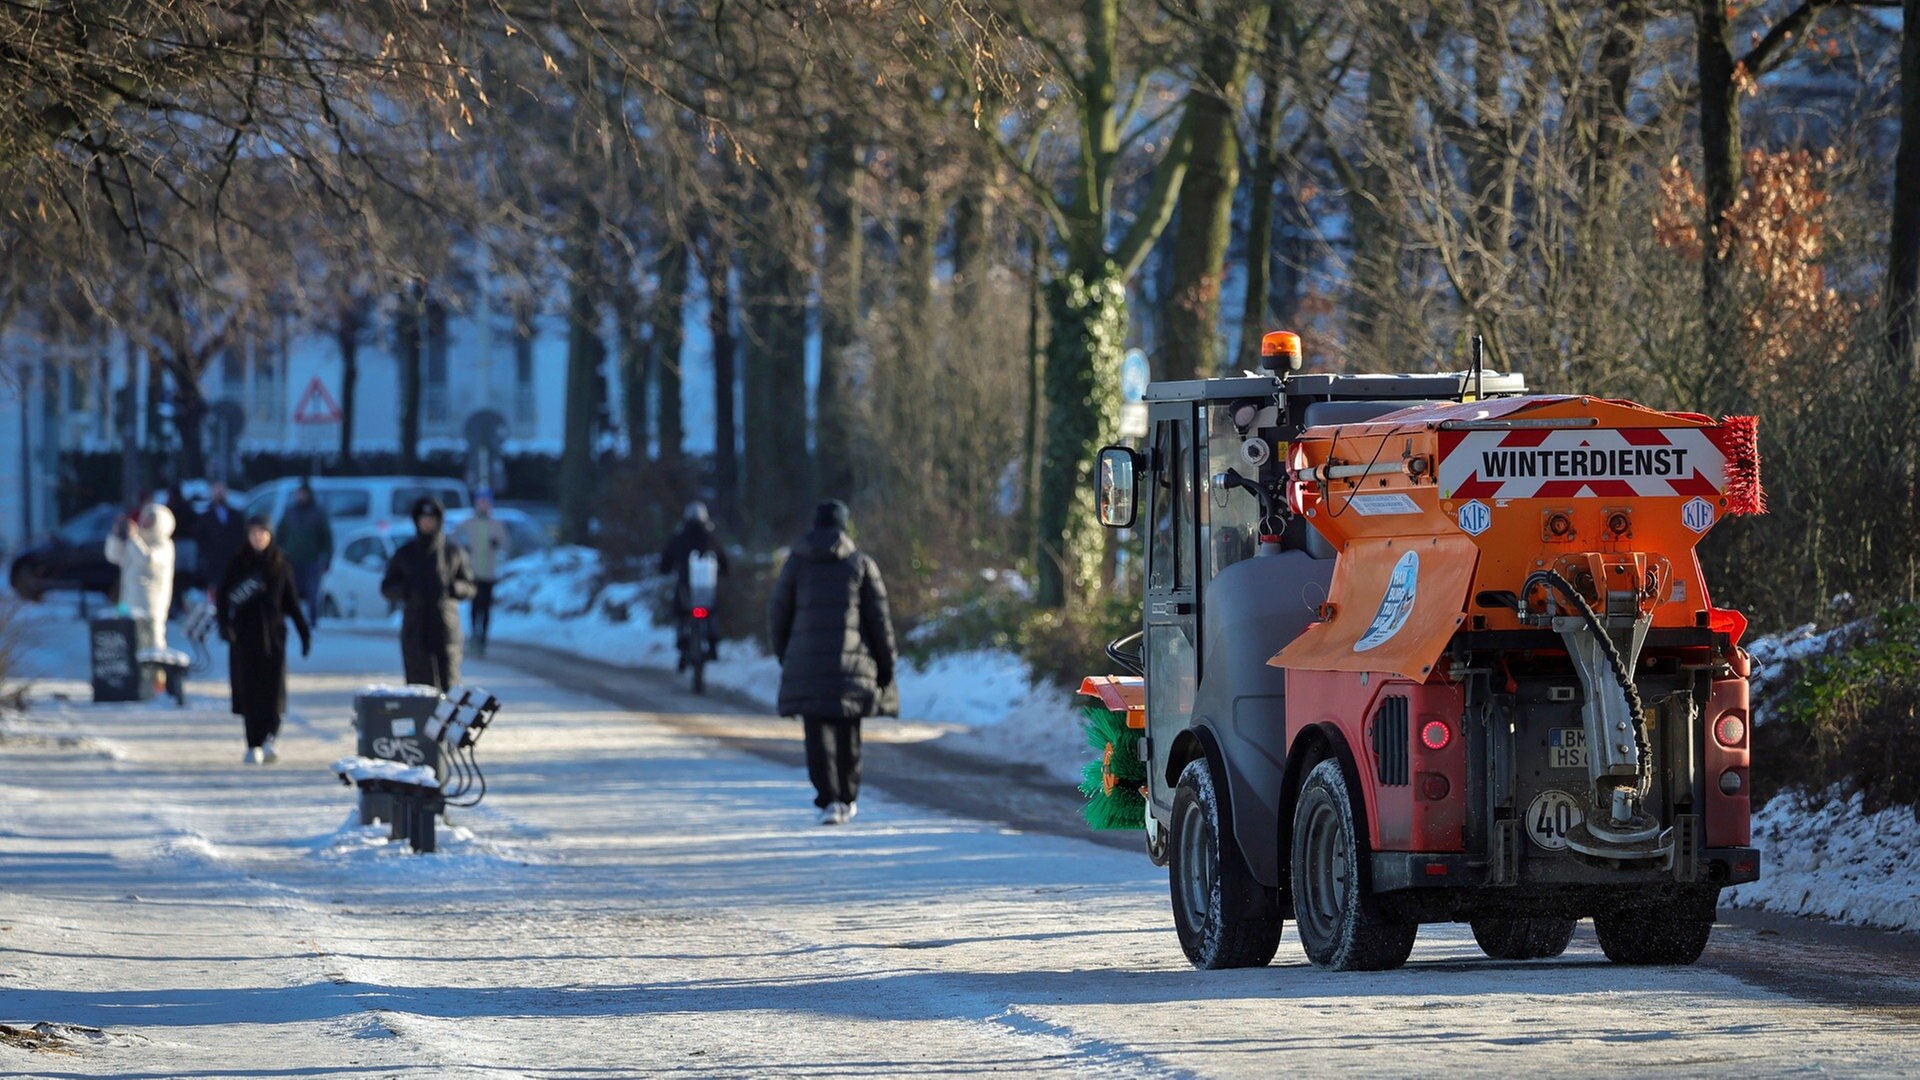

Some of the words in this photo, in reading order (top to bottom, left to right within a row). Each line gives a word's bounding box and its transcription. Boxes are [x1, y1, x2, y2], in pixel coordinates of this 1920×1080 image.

[1482, 448, 1688, 478] WINTERDIENST
[1463, 504, 1486, 531] KIF
[1686, 501, 1710, 528] KIF
[1565, 731, 1587, 748] BM
[1557, 749, 1580, 766] HS
[1536, 801, 1571, 838] 40
